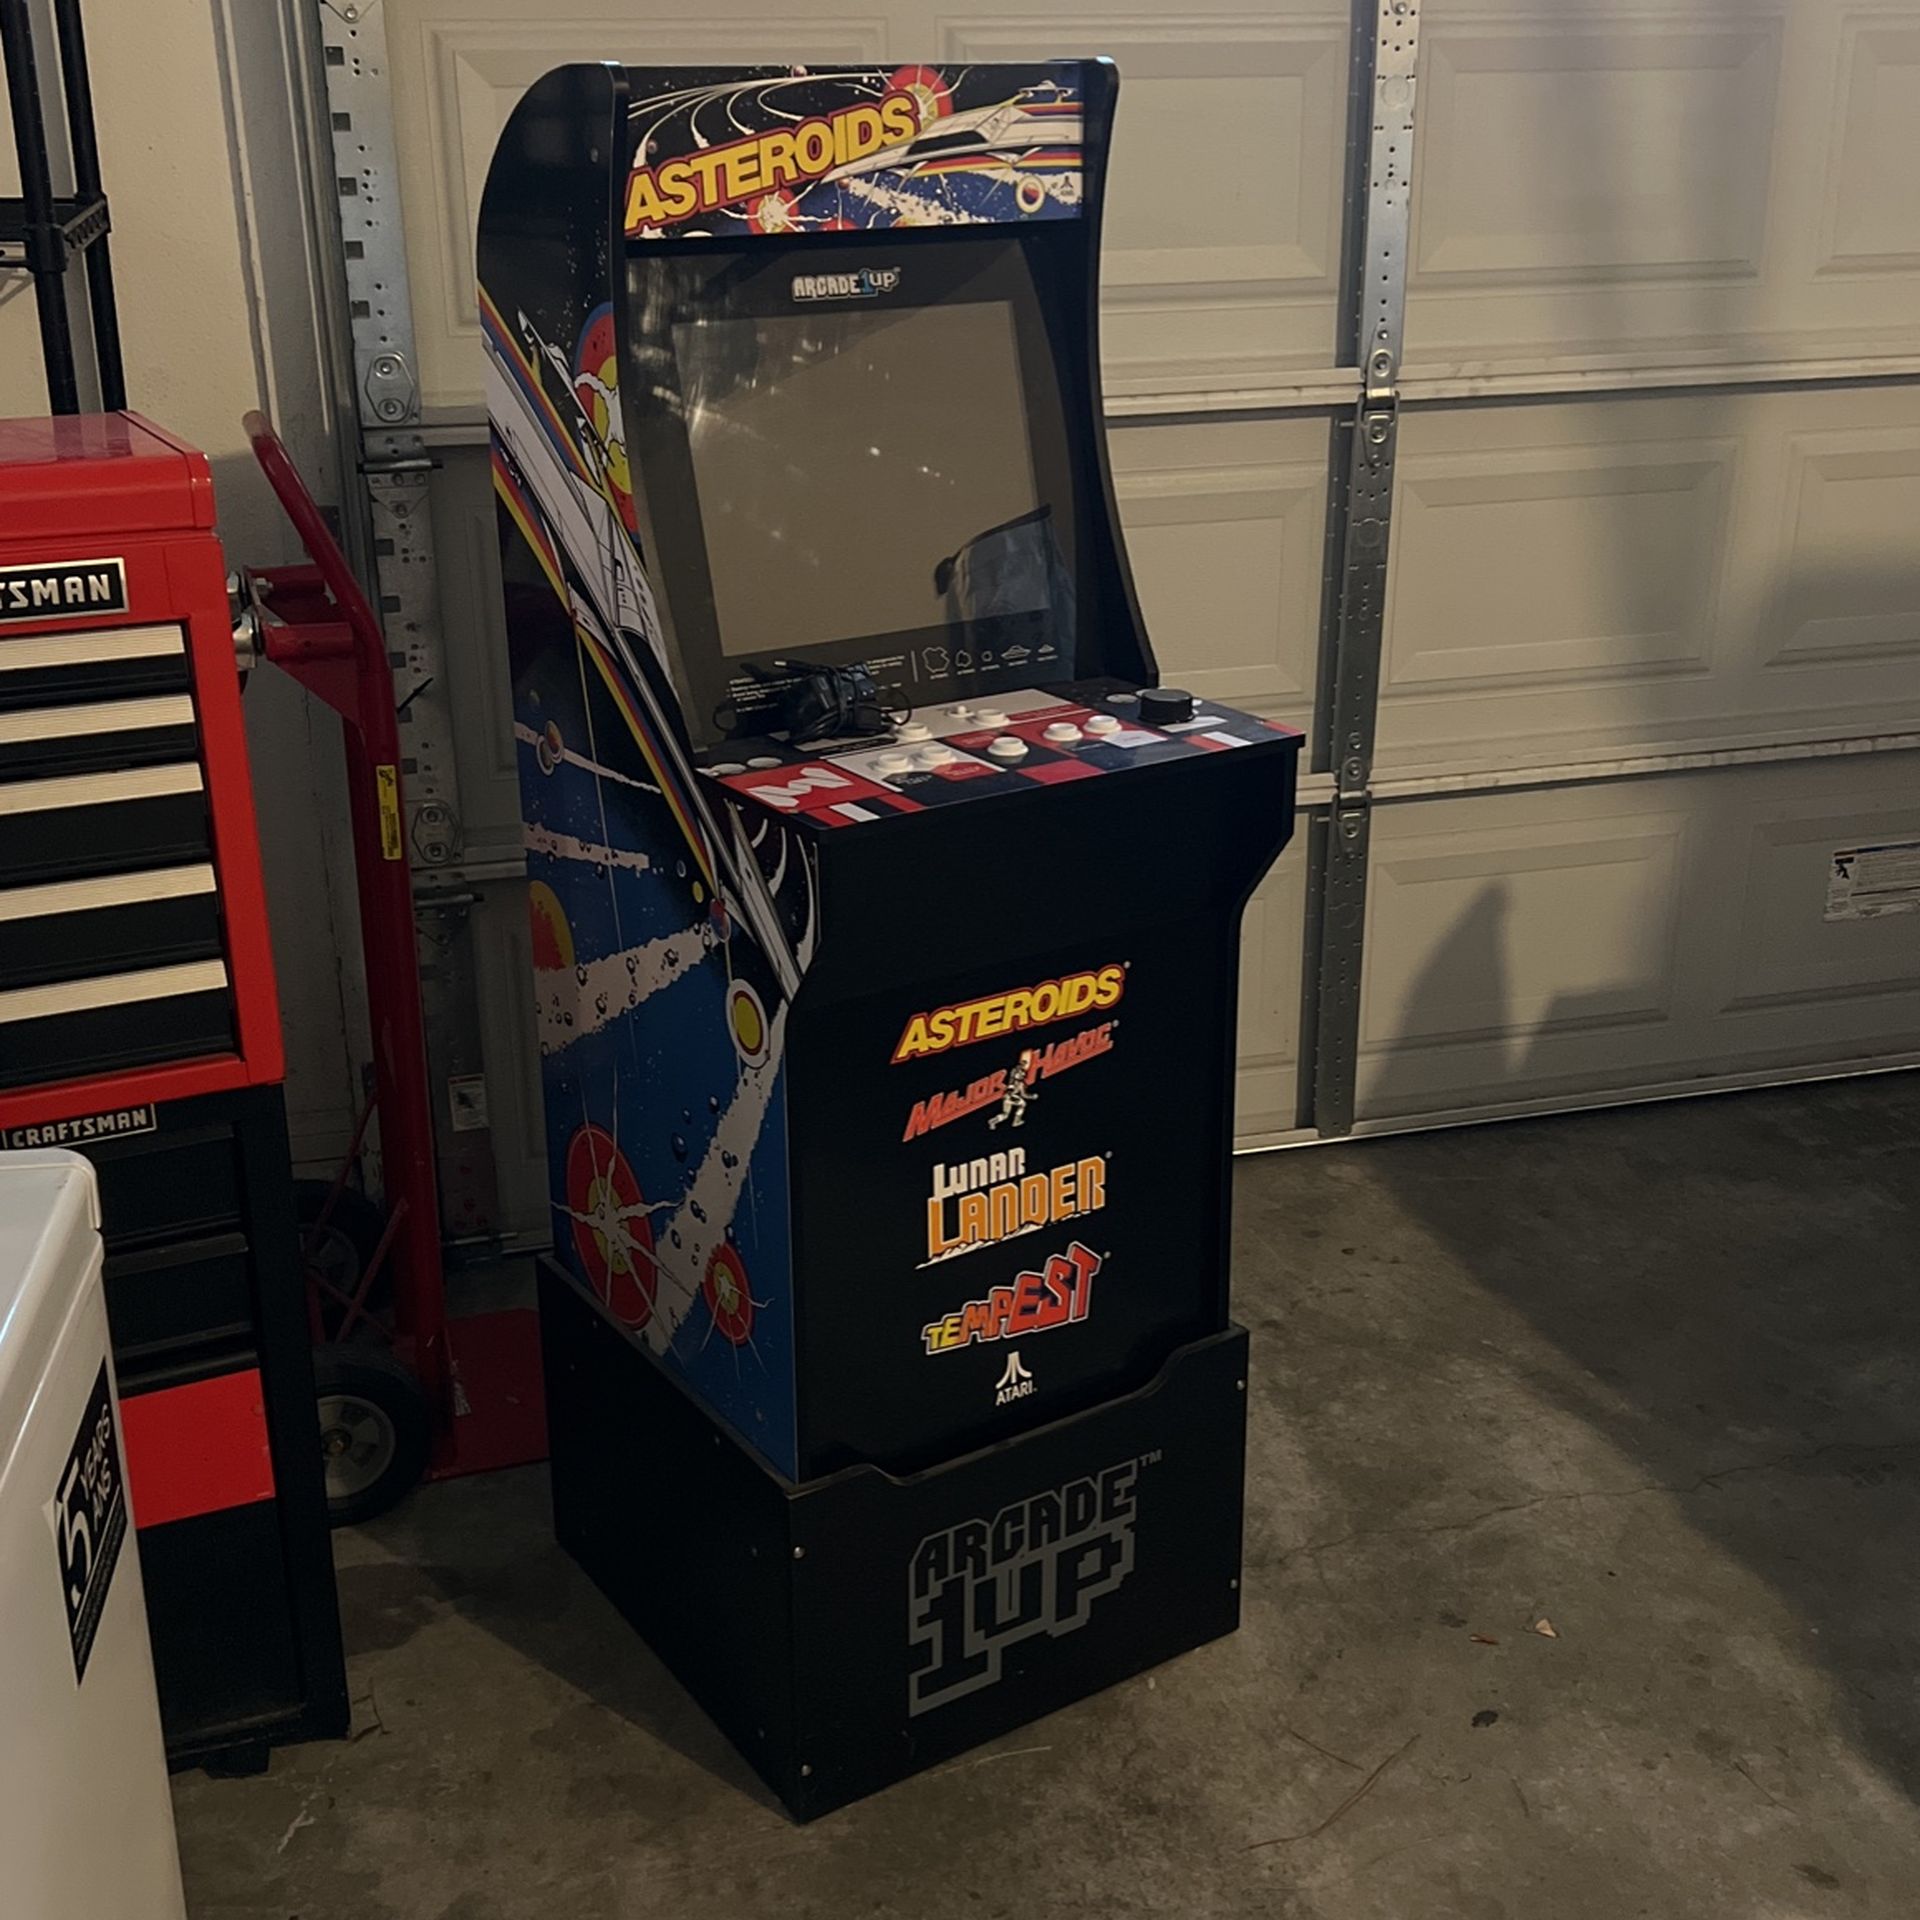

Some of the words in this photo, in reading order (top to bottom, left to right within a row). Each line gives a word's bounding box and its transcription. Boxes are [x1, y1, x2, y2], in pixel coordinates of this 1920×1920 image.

[624, 92, 920, 233] ASTEROIDS
[892, 964, 1124, 1063] ASTEROIDS
[12, 1108, 147, 1147] CRAFTSMAN
[903, 1069, 1007, 1142] MAJOR
[1025, 1022, 1114, 1085] HAVOC
[927, 1156, 1106, 1260] LANDER
[932, 1147, 1025, 1200] LUNAR
[921, 1241, 1101, 1355] TEMPEST
[995, 1380, 1034, 1406] ATARI
[80, 1403, 110, 1500] YEARS
[909, 1458, 1137, 1600] ARCADE
[909, 1530, 1135, 1717] 1UP
